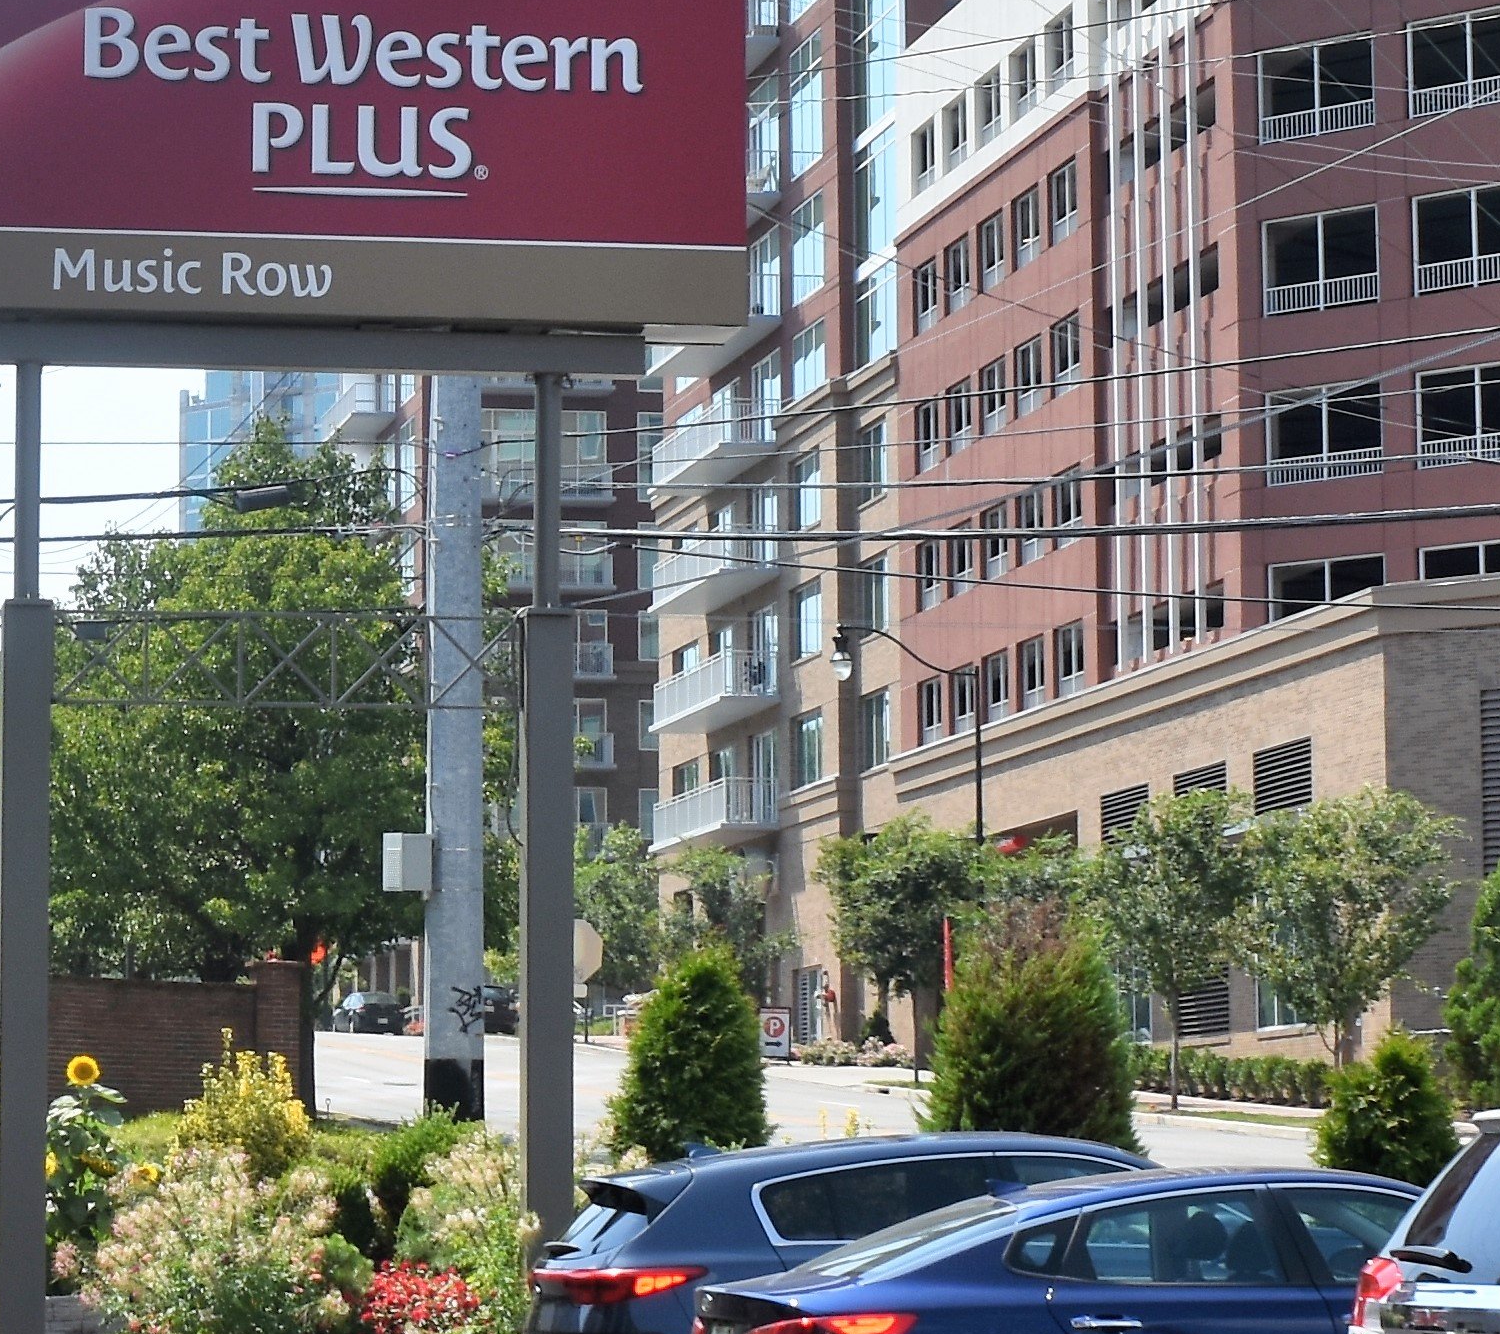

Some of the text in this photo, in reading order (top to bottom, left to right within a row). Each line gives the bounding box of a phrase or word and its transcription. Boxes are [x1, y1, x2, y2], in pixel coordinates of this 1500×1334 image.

[83, 6, 645, 94] Best Western
[51, 246, 335, 301] Music Row
